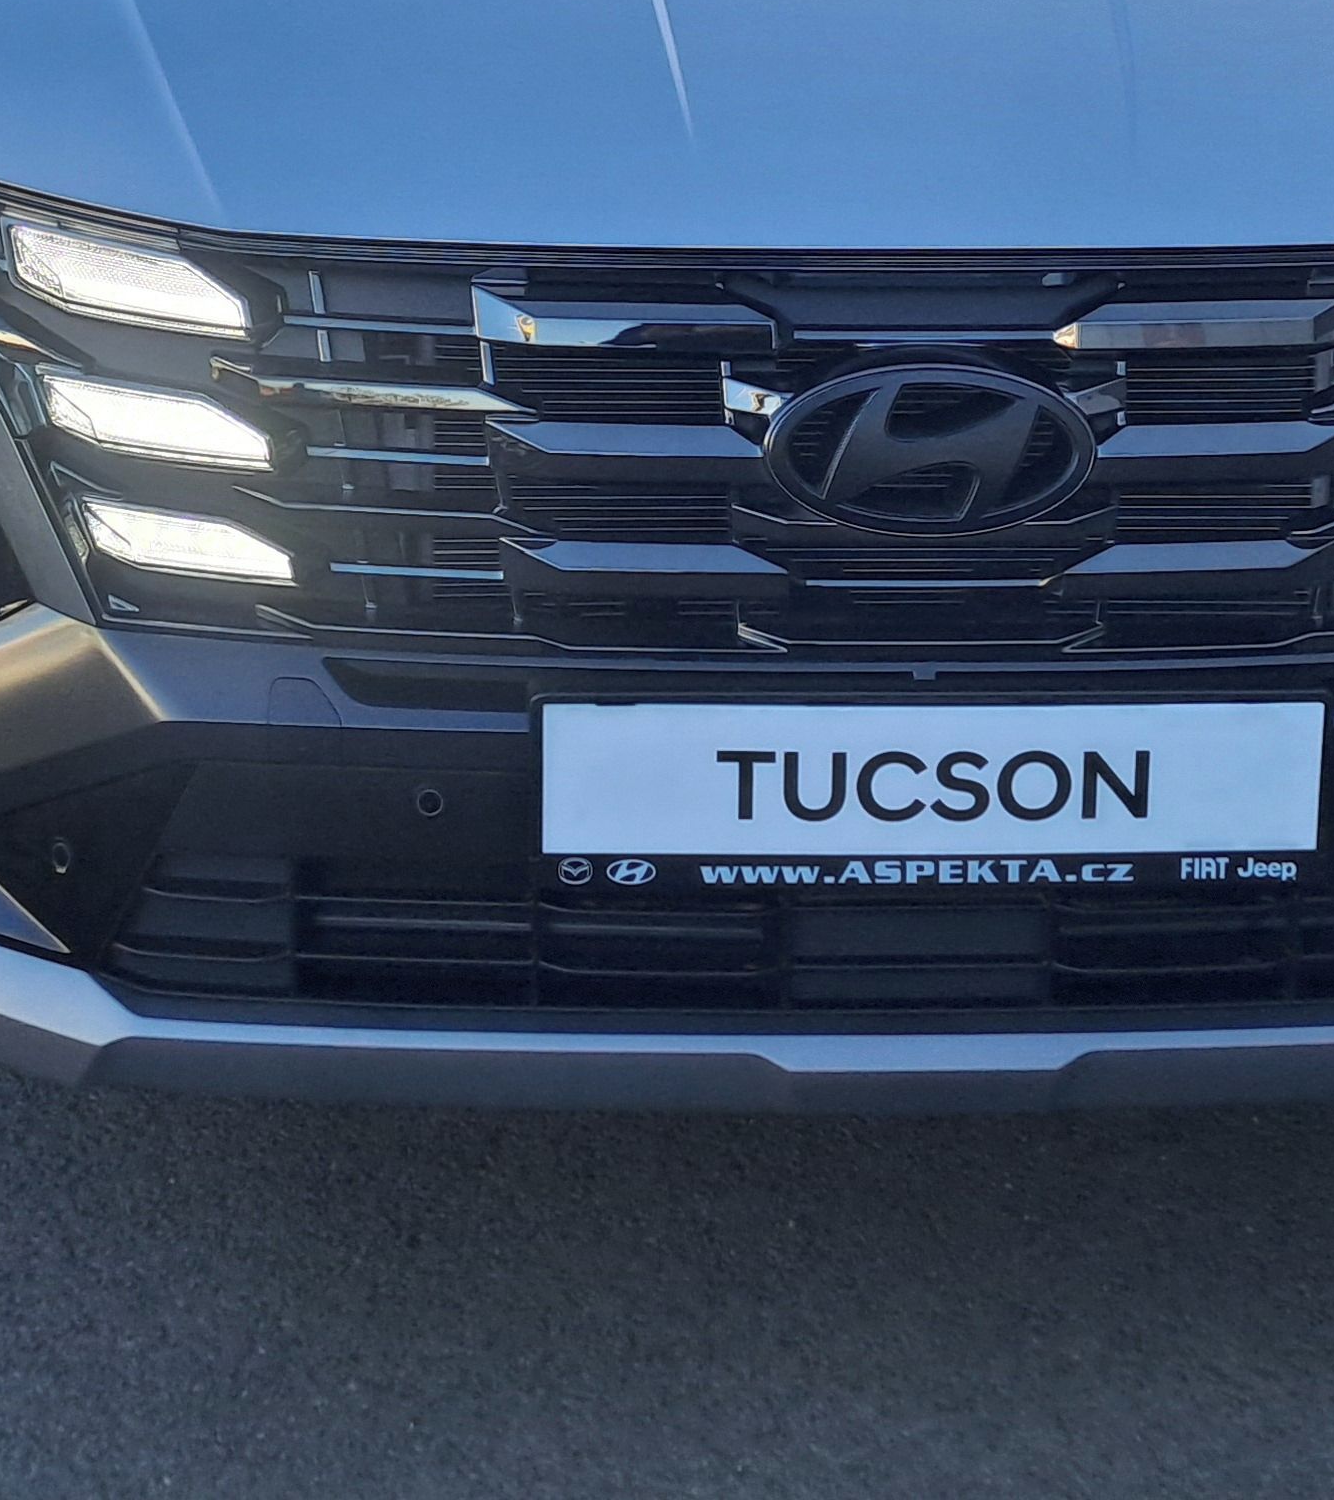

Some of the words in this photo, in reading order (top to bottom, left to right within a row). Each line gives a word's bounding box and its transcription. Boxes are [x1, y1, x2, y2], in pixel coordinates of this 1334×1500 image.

[717, 750, 1150, 821] TUCSON
[699, 859, 1134, 884] www.ASPEKTA.cz
[1180, 857, 1229, 880] FIAT
[1237, 857, 1298, 882] Jeep
